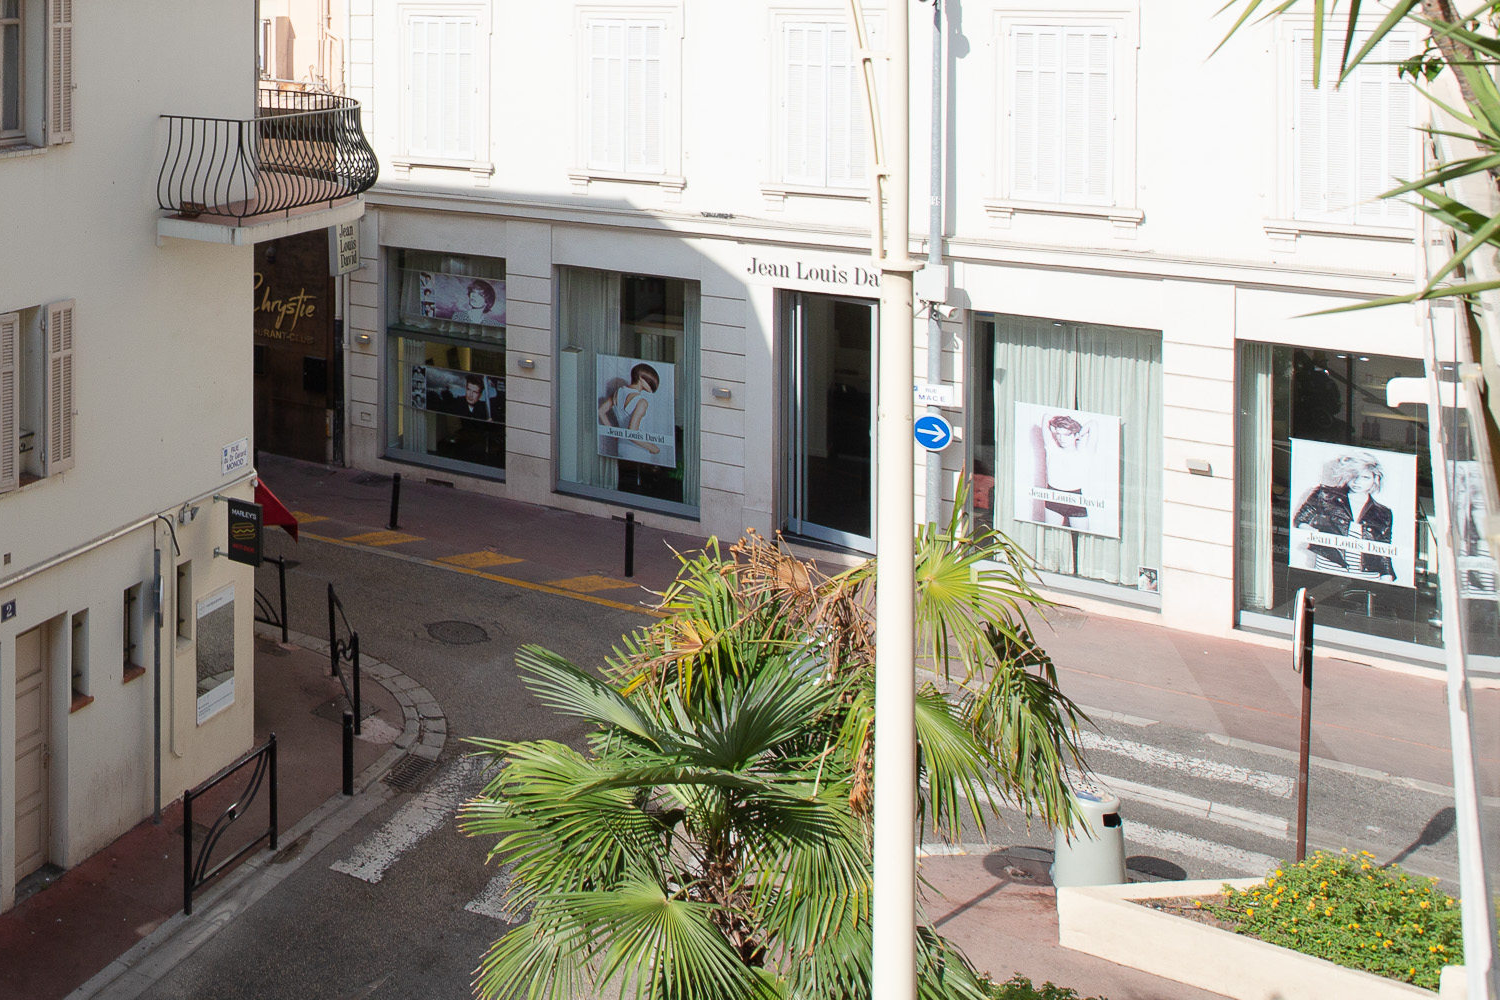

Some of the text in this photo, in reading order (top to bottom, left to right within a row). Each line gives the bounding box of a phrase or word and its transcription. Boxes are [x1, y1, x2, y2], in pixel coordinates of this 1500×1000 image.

[339, 224, 354, 239] Jean
[340, 237, 357, 253] Louis
[340, 250, 358, 268] David
[747, 257, 883, 288] Jean Louis Da
[607, 427, 665, 444] Jean Louis David
[1028, 488, 1105, 509] Jean Louis David
[1306, 532, 1397, 556] Jean Louis David
[6, 604, 13, 618] 2
